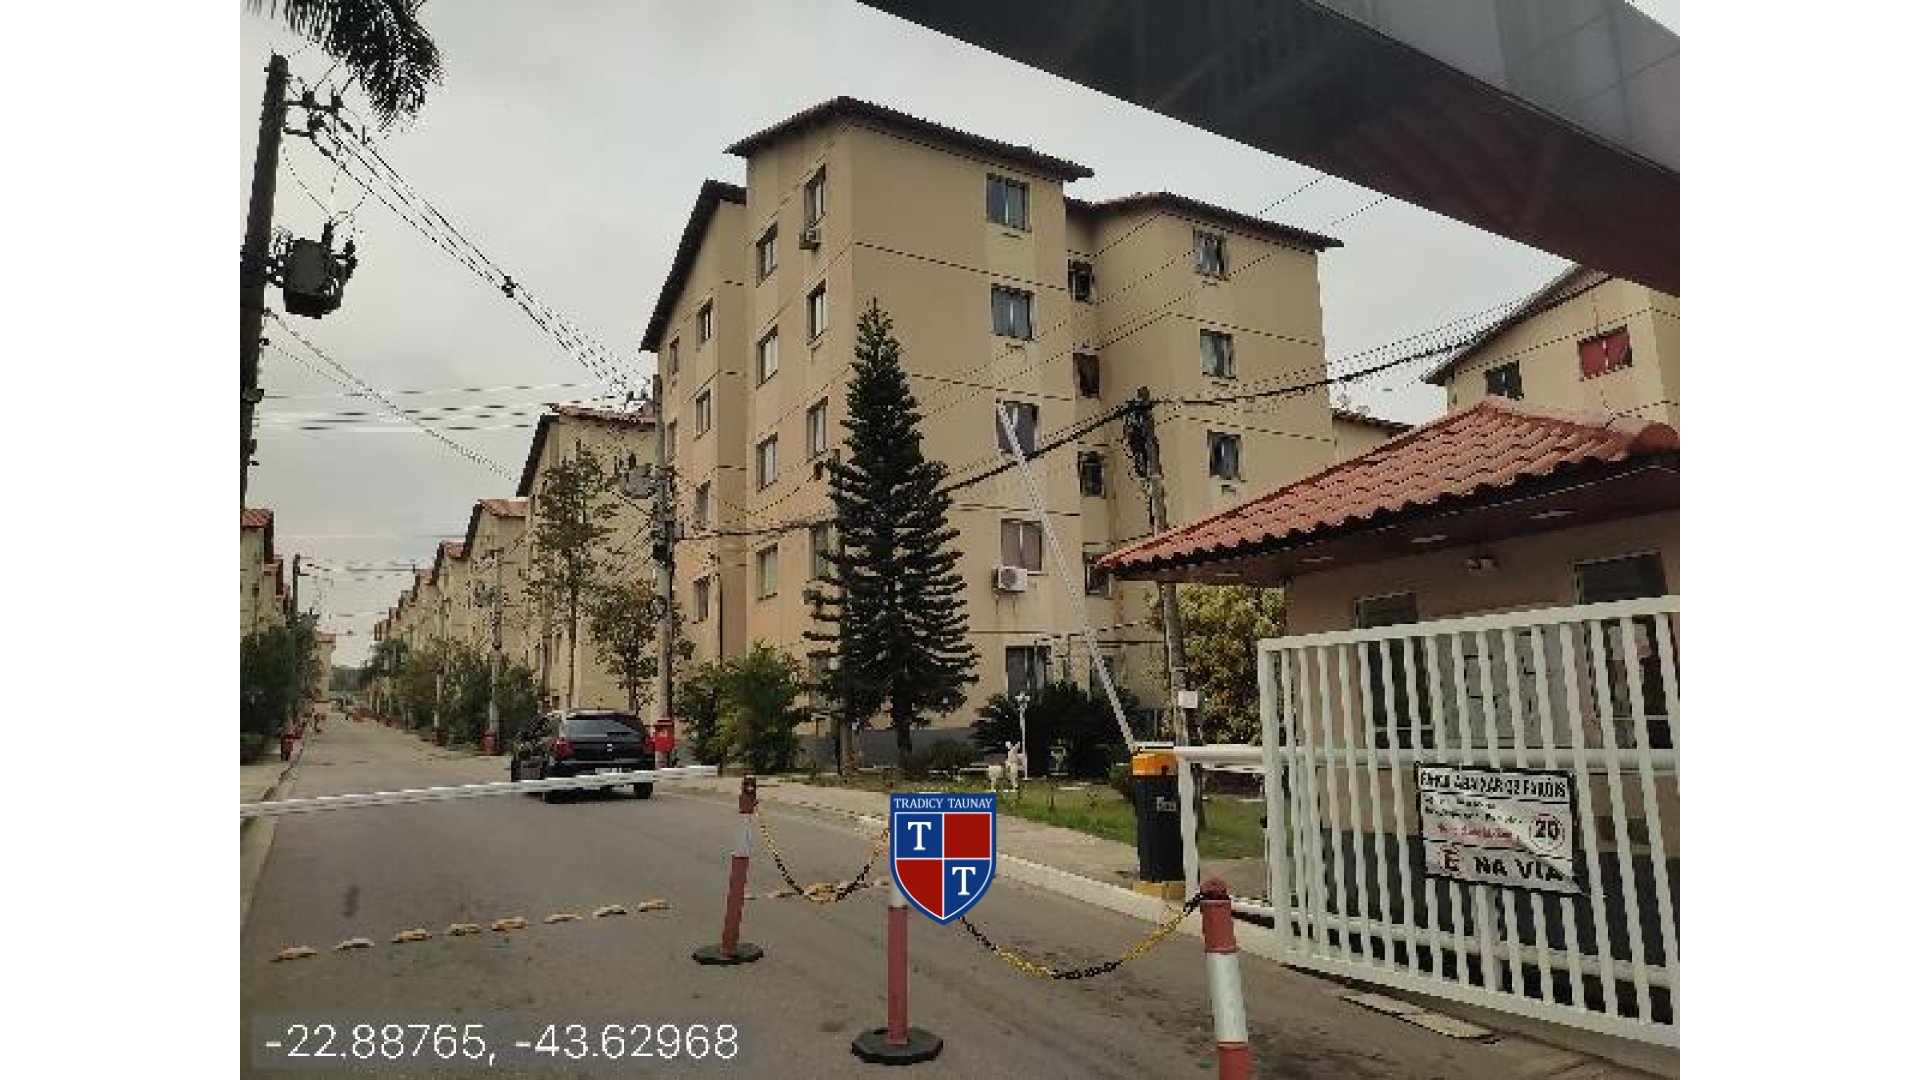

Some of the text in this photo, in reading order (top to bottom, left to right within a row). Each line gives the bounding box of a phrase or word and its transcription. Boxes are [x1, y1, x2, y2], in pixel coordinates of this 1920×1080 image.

[1534, 819, 1561, 840] 20
[1474, 857, 1508, 876] NA
[1514, 858, 1564, 881] VIA
